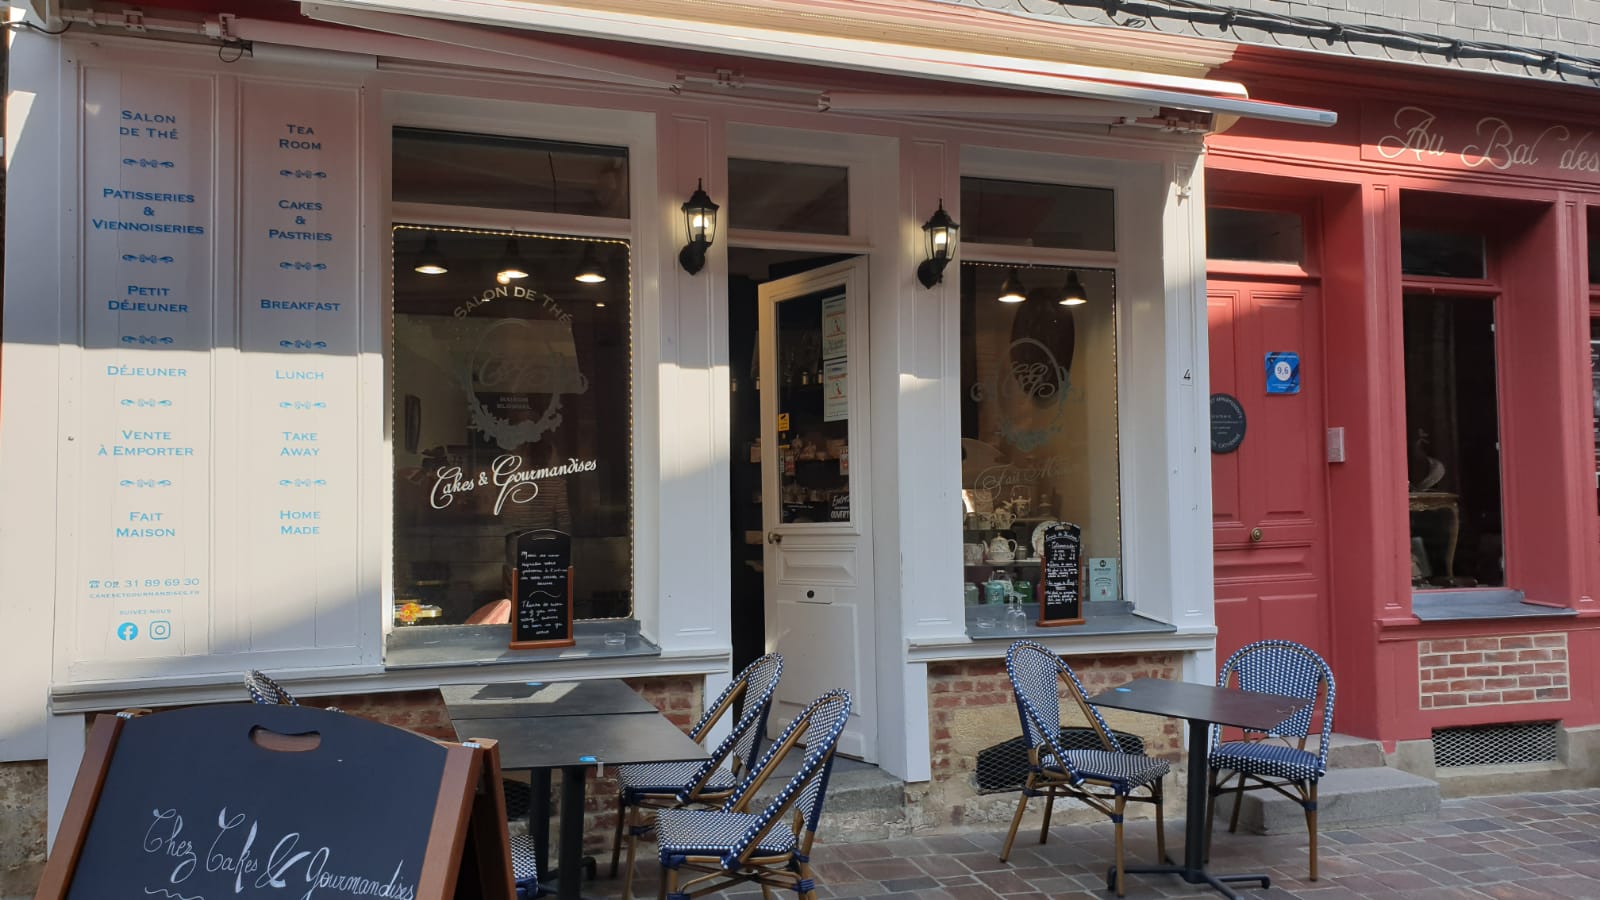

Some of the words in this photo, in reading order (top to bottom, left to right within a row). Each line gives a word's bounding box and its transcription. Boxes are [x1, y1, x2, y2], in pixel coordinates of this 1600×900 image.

[1377, 106, 1446, 161] Au
[1460, 117, 1570, 170] Bal
[143, 205, 155, 217] &
[295, 215, 306, 225] &
[513, 286, 537, 302] DE
[1183, 368, 1192, 381] 4
[430, 465, 475, 510] Cakes
[478, 471, 488, 486] &
[491, 454, 597, 516] Gourmandises
[125, 580, 139, 589] 31
[144, 579, 160, 587] 89
[164, 578, 180, 587] 69
[183, 578, 200, 586] 30
[144, 808, 197, 883] Chez
[206, 806, 259, 893] Cakes
[255, 833, 311, 888] &
[301, 847, 415, 900] Gourmandises
